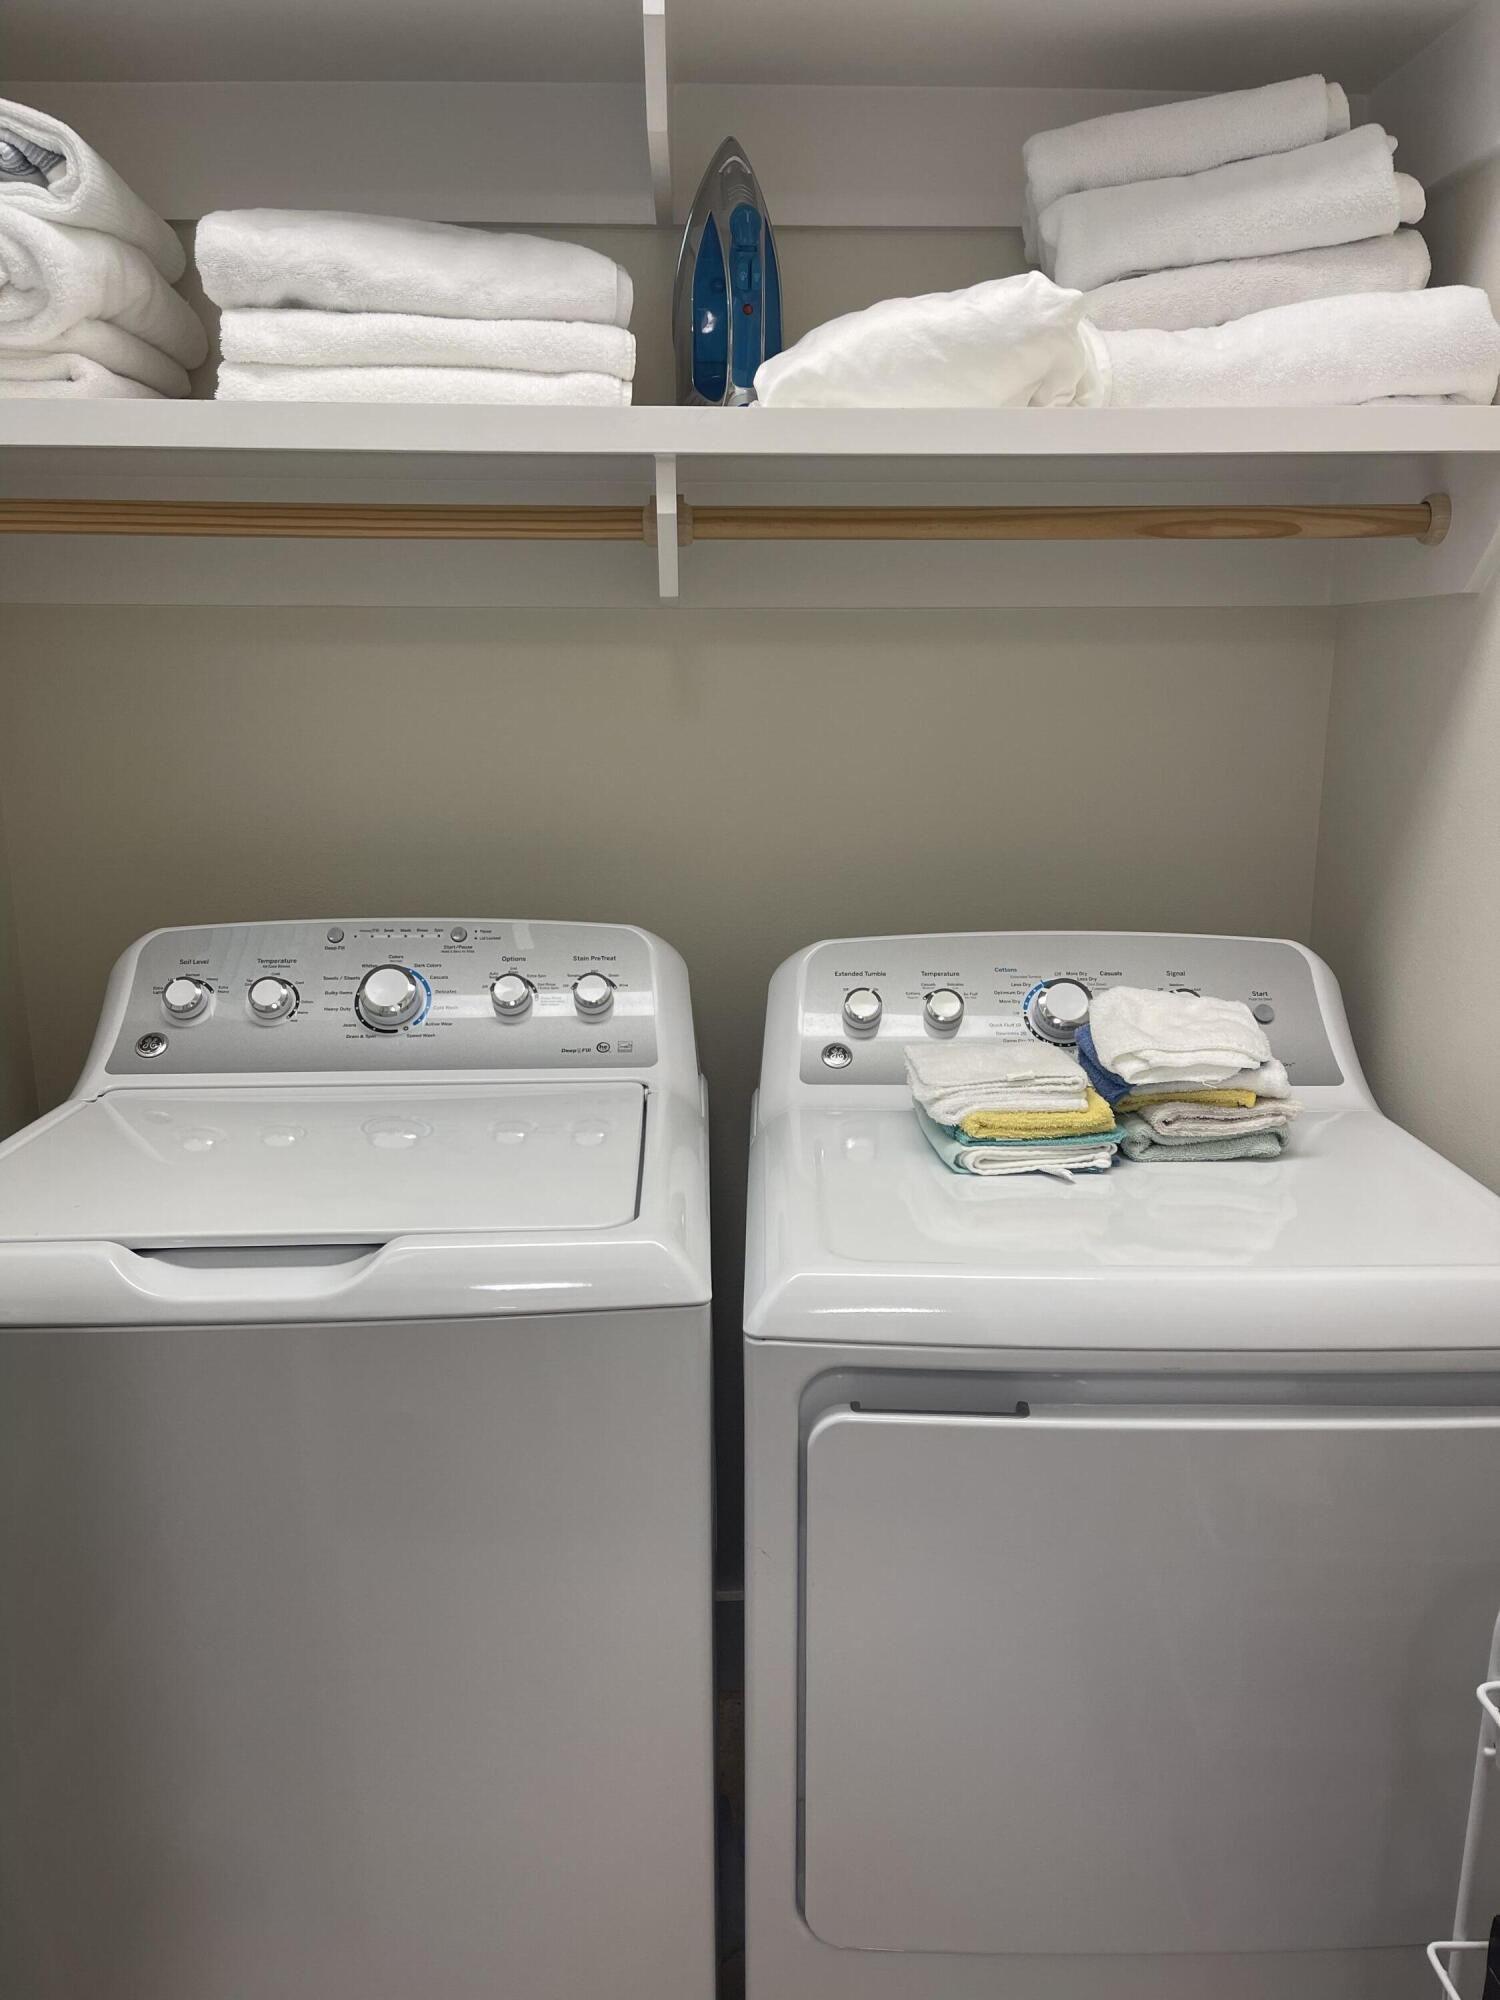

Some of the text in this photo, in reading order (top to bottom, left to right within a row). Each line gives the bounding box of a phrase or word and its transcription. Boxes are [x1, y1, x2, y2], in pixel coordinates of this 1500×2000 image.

[501, 955, 527, 963] Options
[921, 970, 960, 978] Temperature
[1166, 970, 1186, 978] Signal
